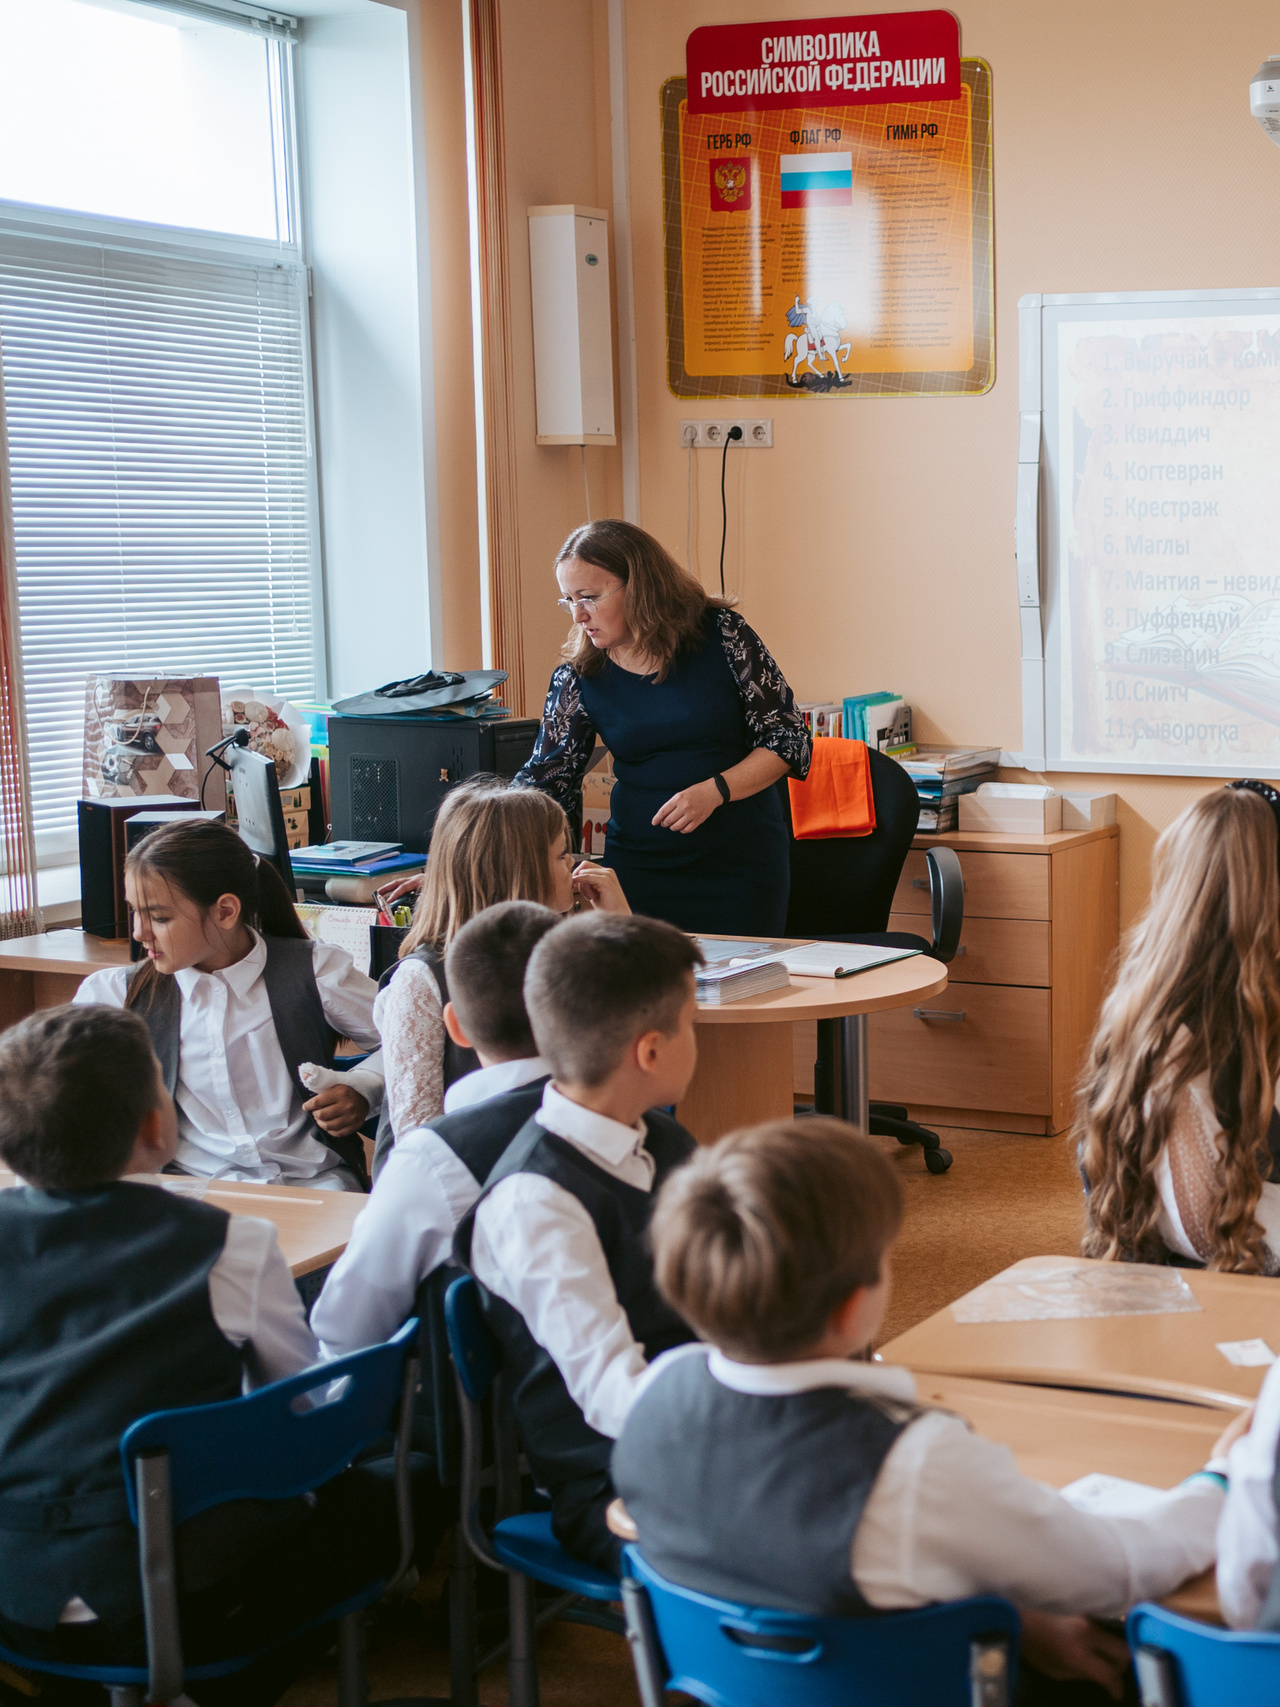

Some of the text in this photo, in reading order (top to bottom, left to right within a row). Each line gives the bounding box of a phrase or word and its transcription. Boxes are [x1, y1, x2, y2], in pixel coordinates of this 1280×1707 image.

[761, 30, 881, 64] СИМВОЛИКА
[700, 57, 946, 98] РОССИЙСКОЙ ФЕДЕРАЦИИ
[707, 132, 752, 150] ГЕРБ РФ
[789, 127, 842, 146] ФЛАГ РФ
[886, 122, 939, 142] ГИМН РФ
[1123, 346, 1210, 375] Выручай
[1102, 385, 1251, 413] 2. Гриффиндор
[1102, 423, 1211, 447] 3. Квиддич
[1102, 460, 1224, 486] 4. Когтевран
[1103, 496, 1219, 522] 5. Крестраж
[1103, 534, 1190, 555] 6. Маглы
[1104, 570, 1120, 591] 7.
[1125, 570, 1201, 591] Мантия
[1103, 606, 1240, 634] 8. Пуффендуй
[1125, 643, 1220, 669] Слизерин
[355, 915, 373, 925] 2023
